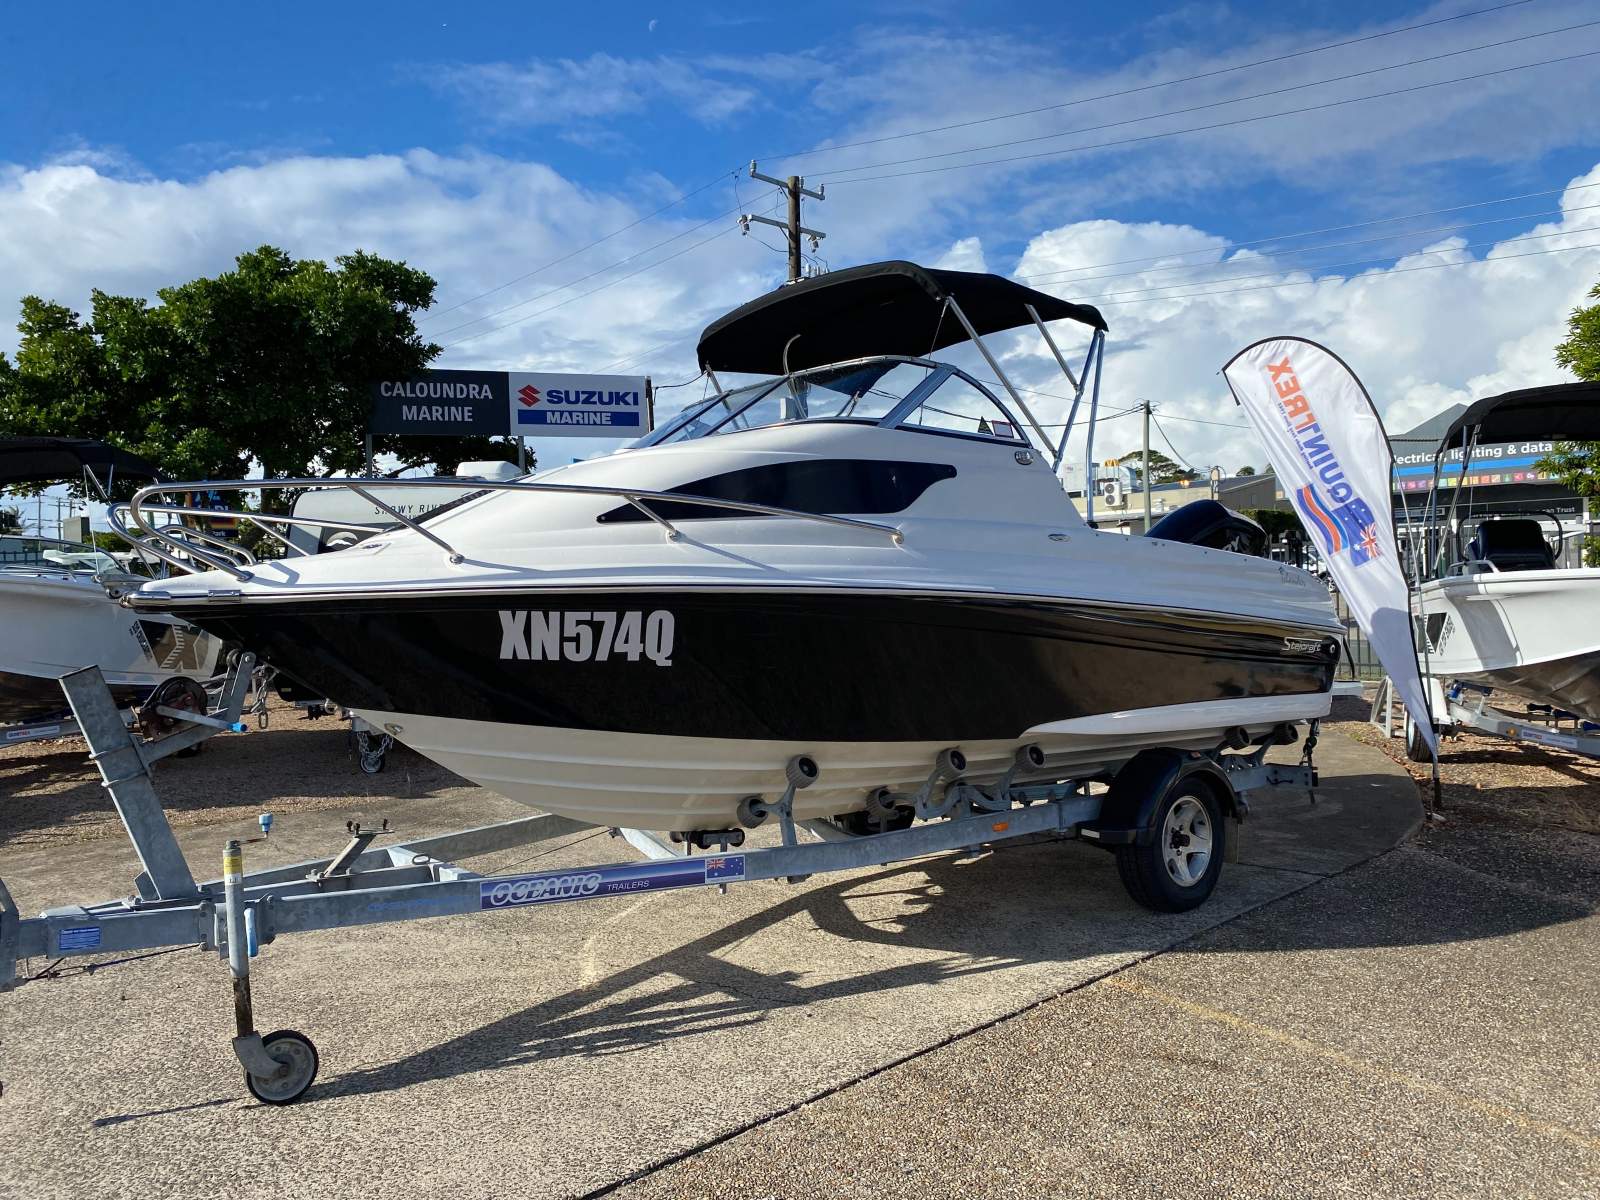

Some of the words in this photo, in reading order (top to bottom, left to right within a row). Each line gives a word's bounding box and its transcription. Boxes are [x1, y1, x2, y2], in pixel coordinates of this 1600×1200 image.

[380, 381, 493, 400] CALOUNDRA
[546, 389, 639, 406] SUZUKI
[402, 405, 473, 422] MARINE
[546, 411, 612, 425] MARINE
[1507, 445, 1517, 455] &
[1521, 443, 1553, 454] data
[499, 610, 675, 667] XN574Q
[490, 873, 602, 906] OCEANIC
[607, 880, 650, 892] TRAILERS
